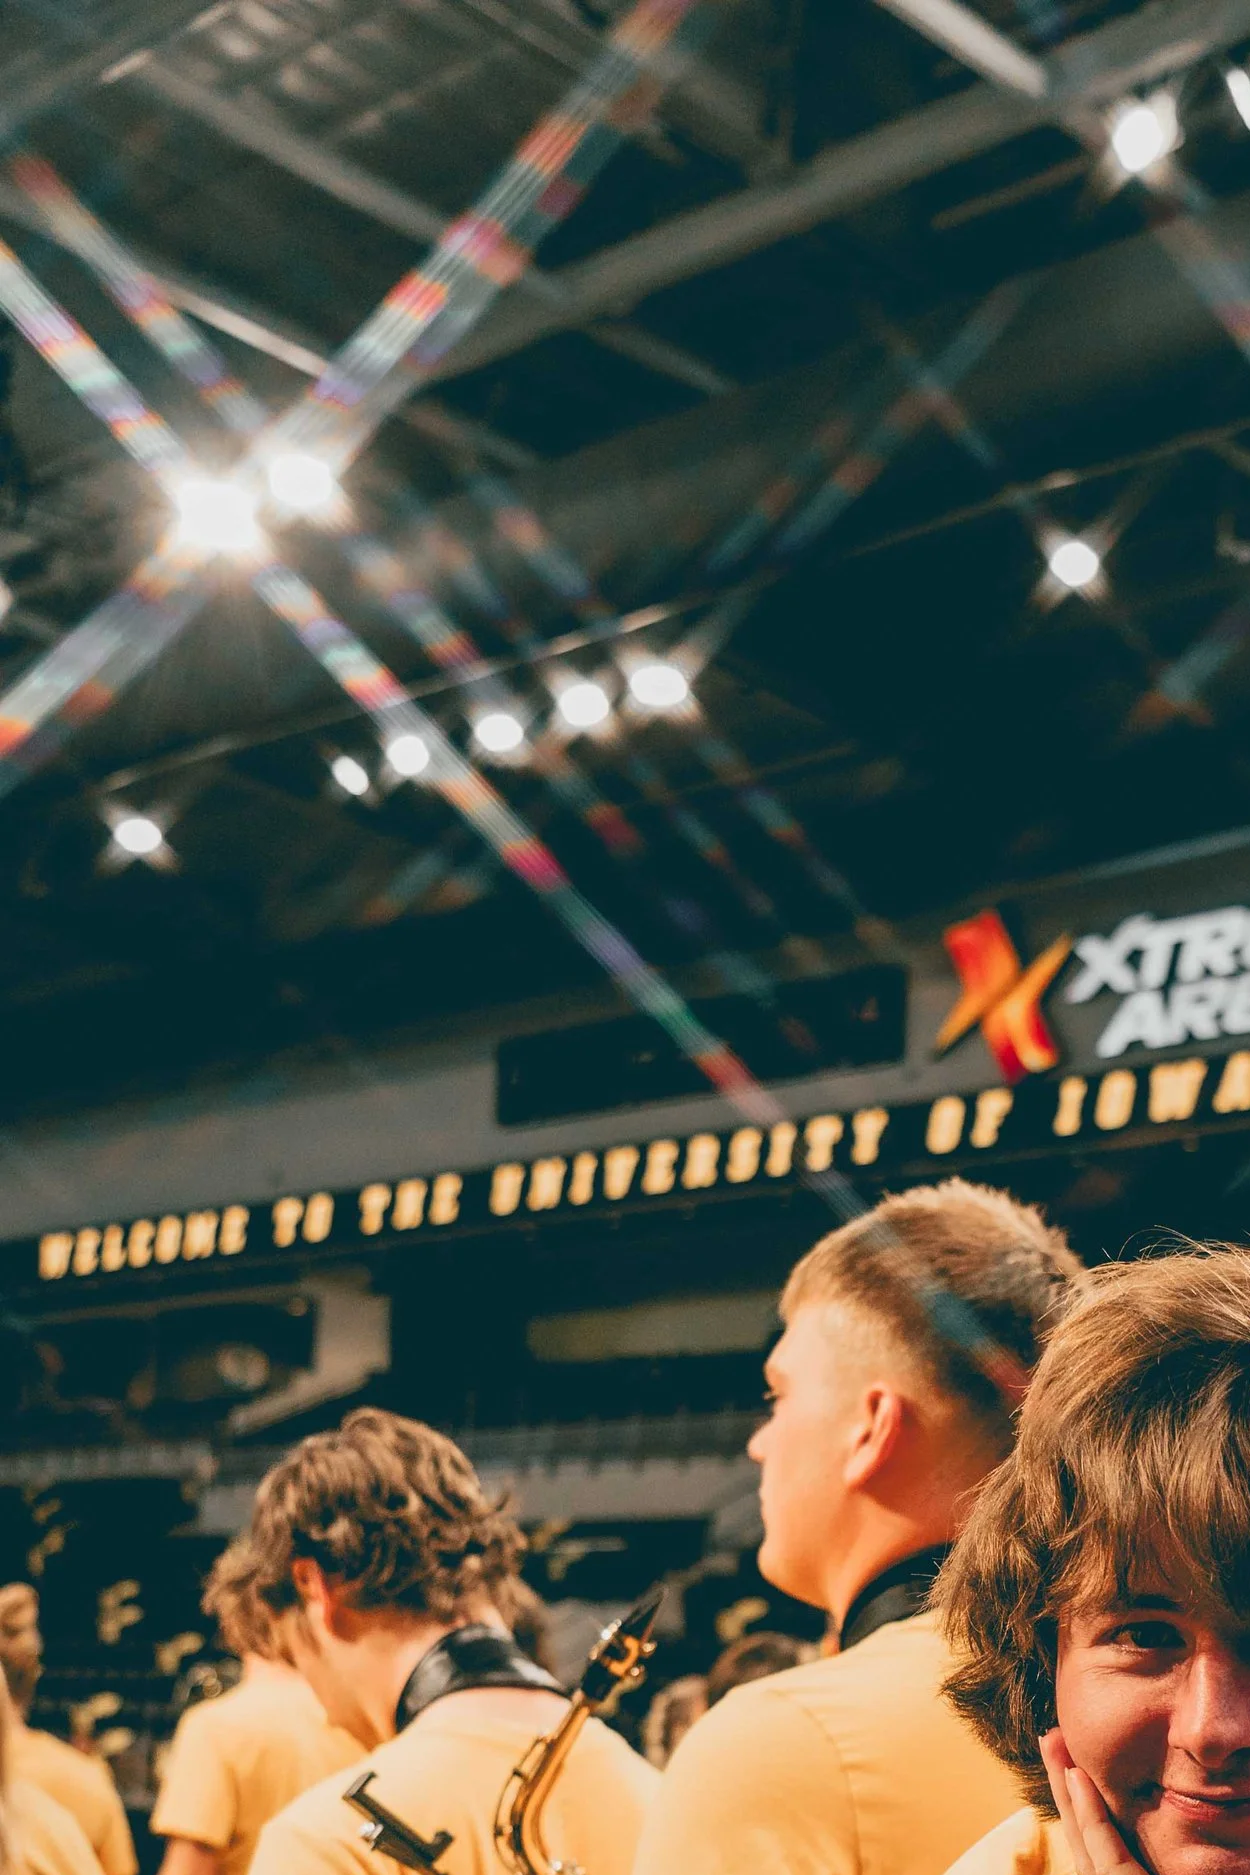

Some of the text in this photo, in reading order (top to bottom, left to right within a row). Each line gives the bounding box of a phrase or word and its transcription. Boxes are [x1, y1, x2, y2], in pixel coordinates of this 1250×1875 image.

[39, 1204, 250, 1280] WELCOME
[272, 1192, 335, 1248] TO
[358, 1172, 463, 1236] THE
[489, 1107, 889, 1217] UNIVERSITY
[925, 1087, 1013, 1155] OF
